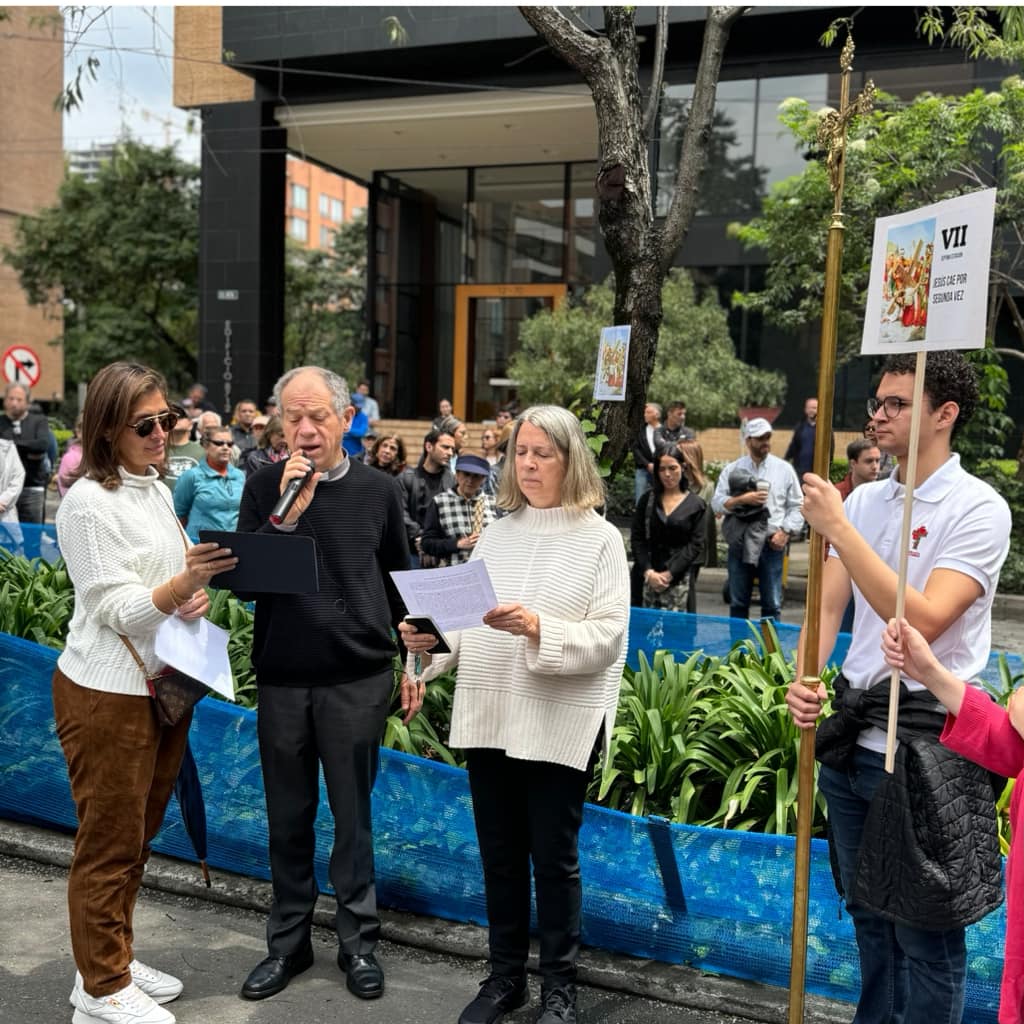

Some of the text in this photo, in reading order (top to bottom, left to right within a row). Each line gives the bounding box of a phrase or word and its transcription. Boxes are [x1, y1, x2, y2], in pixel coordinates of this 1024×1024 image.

[941, 223, 968, 251] VII
[946, 274, 956, 286] CAE
[956, 272, 968, 285] POR
[932, 289, 965, 305] SEGUNDA VEZ
